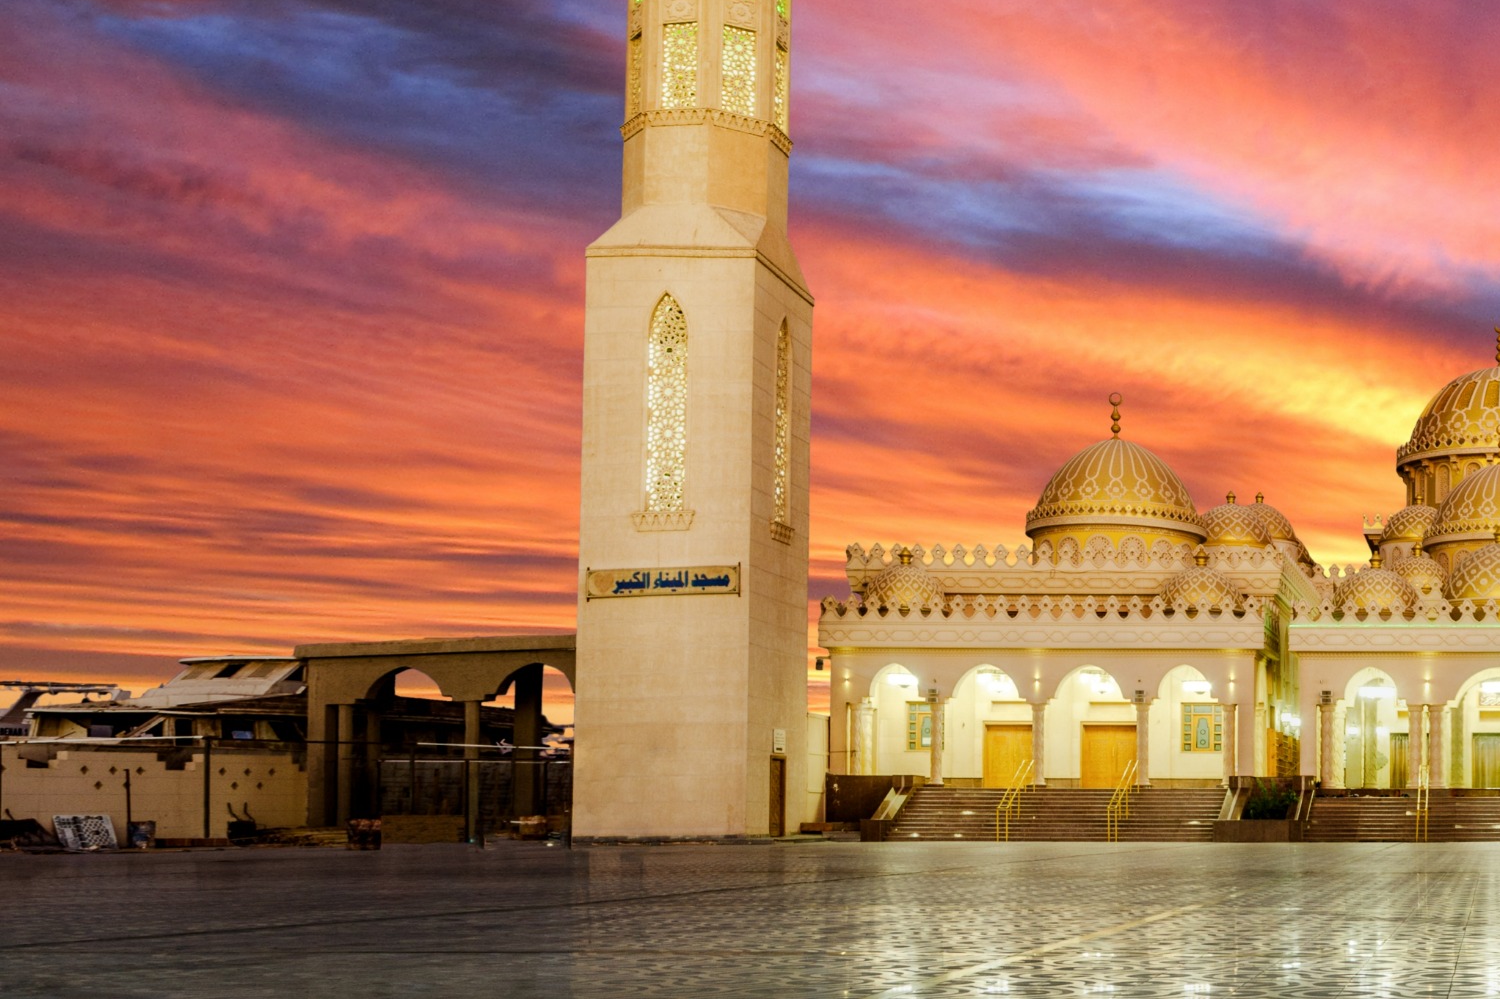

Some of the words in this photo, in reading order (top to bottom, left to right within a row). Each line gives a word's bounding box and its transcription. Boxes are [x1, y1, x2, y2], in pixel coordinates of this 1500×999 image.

[612, 571, 651, 594] الكبير
[653, 570, 689, 592] الميناء
[691, 573, 730, 591] مسجد
